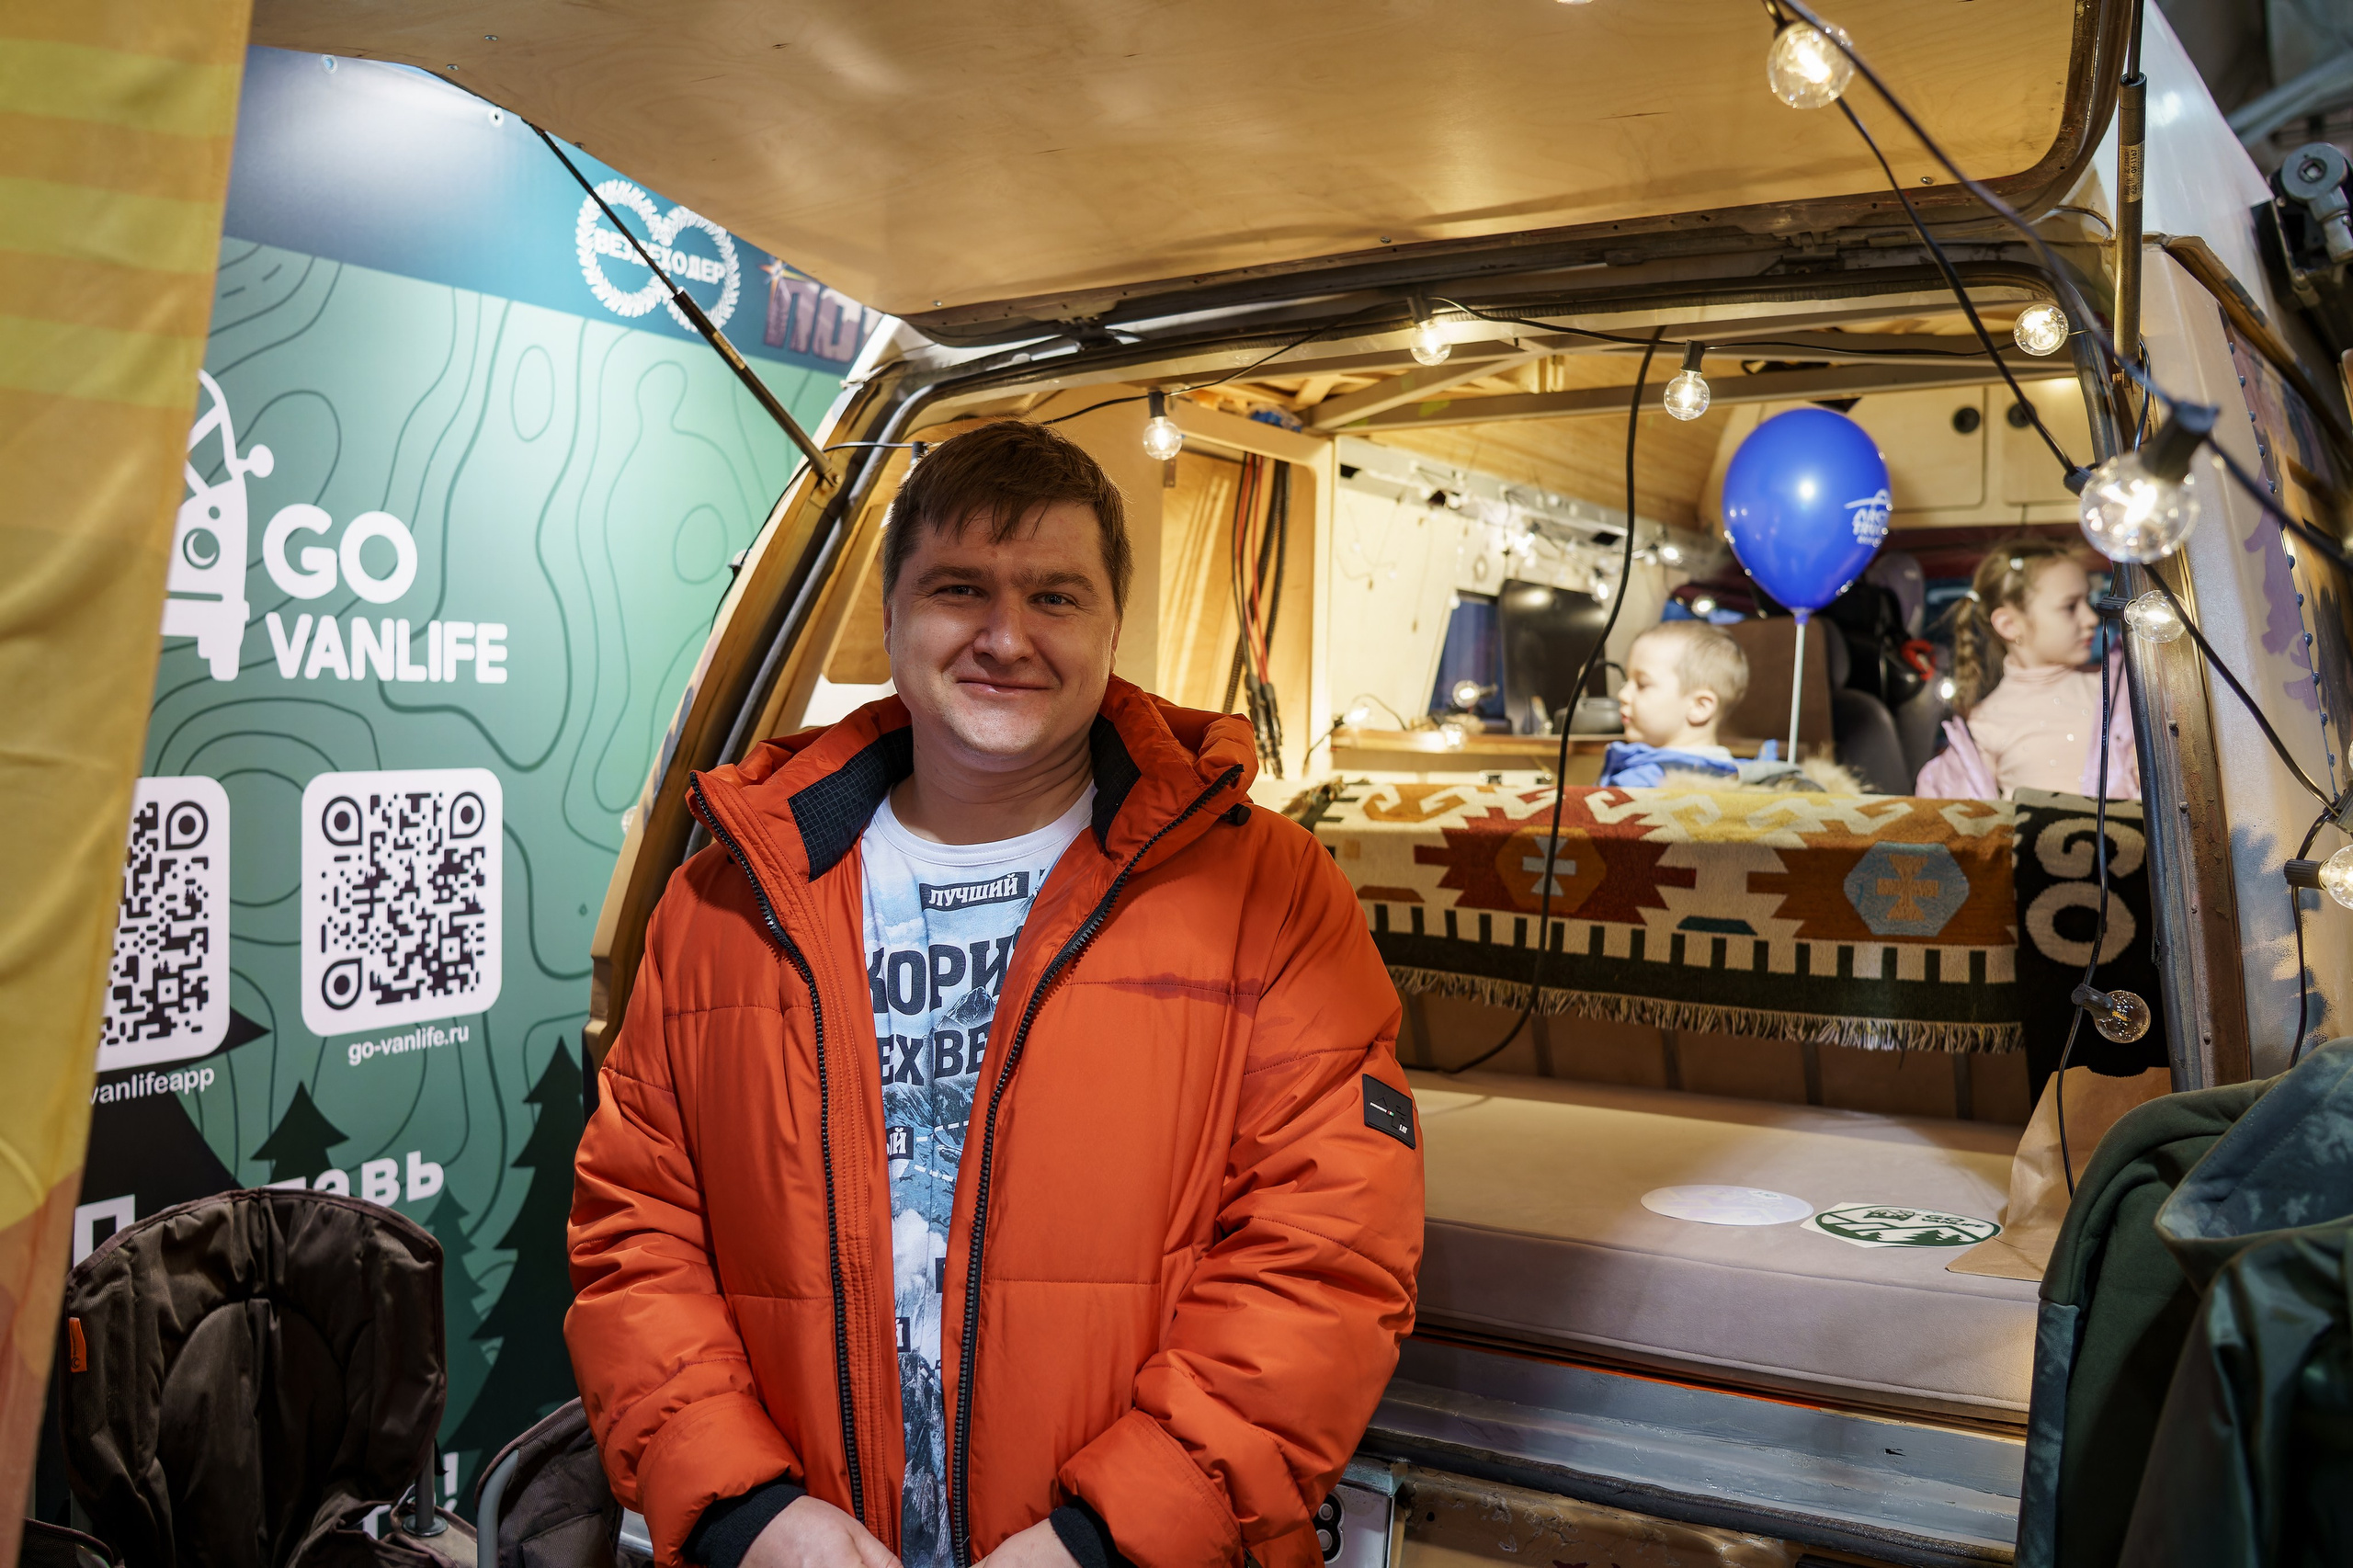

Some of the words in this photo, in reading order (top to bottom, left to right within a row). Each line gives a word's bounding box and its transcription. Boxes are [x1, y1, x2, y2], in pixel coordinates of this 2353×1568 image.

[262, 503, 418, 604] GO
[266, 611, 508, 684] VANLIFE
[928, 874, 1018, 908] ЛУЧШИЙ
[347, 1025, 470, 1066] go-vanlife.ru
